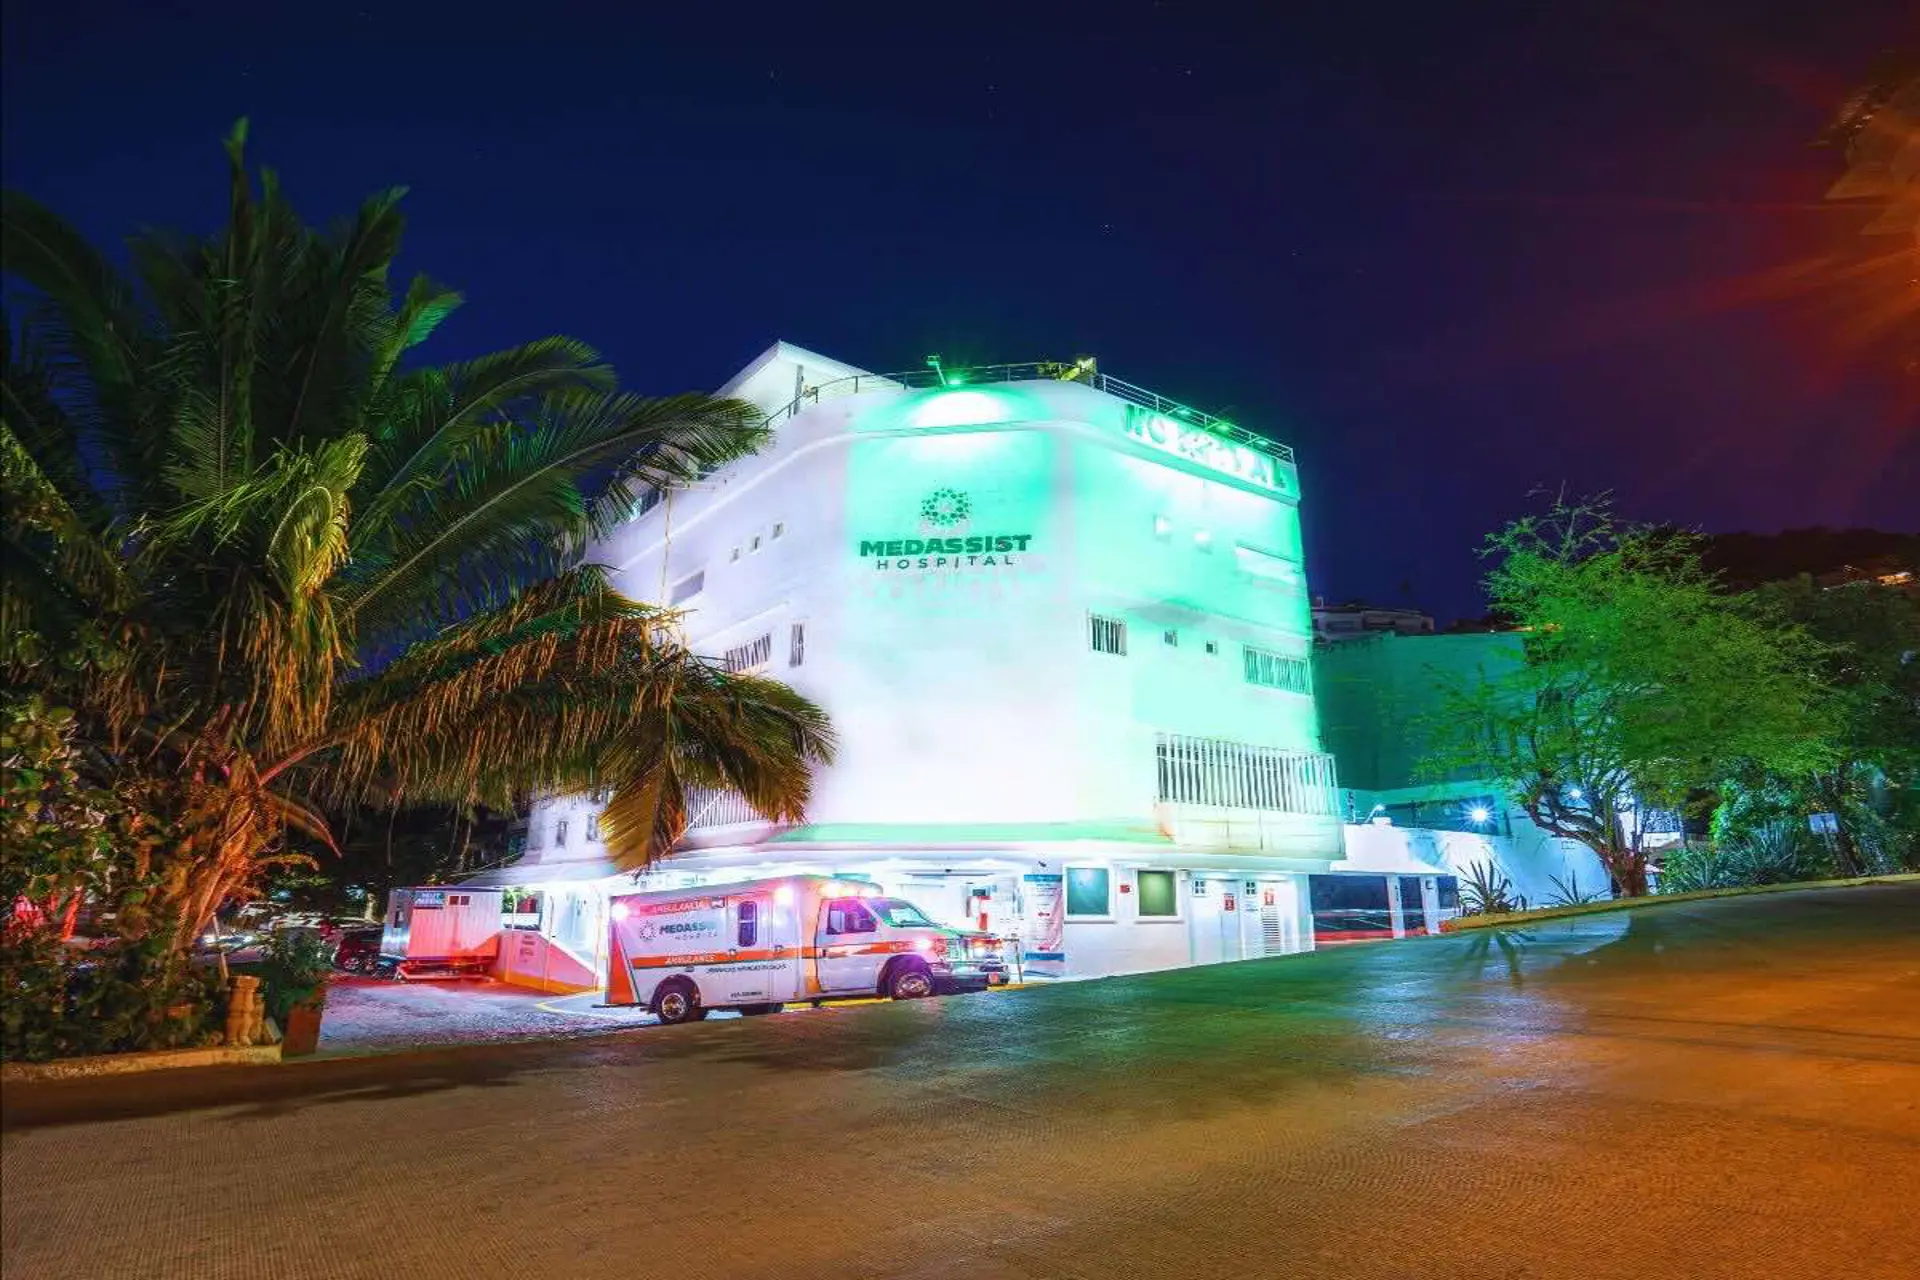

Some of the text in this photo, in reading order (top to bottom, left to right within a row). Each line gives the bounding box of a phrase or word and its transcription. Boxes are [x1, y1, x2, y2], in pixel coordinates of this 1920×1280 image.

[860, 534, 1032, 557] MEDASSIST
[877, 555, 1014, 570] HOSPITAL
[659, 921, 715, 934] MEDASS
